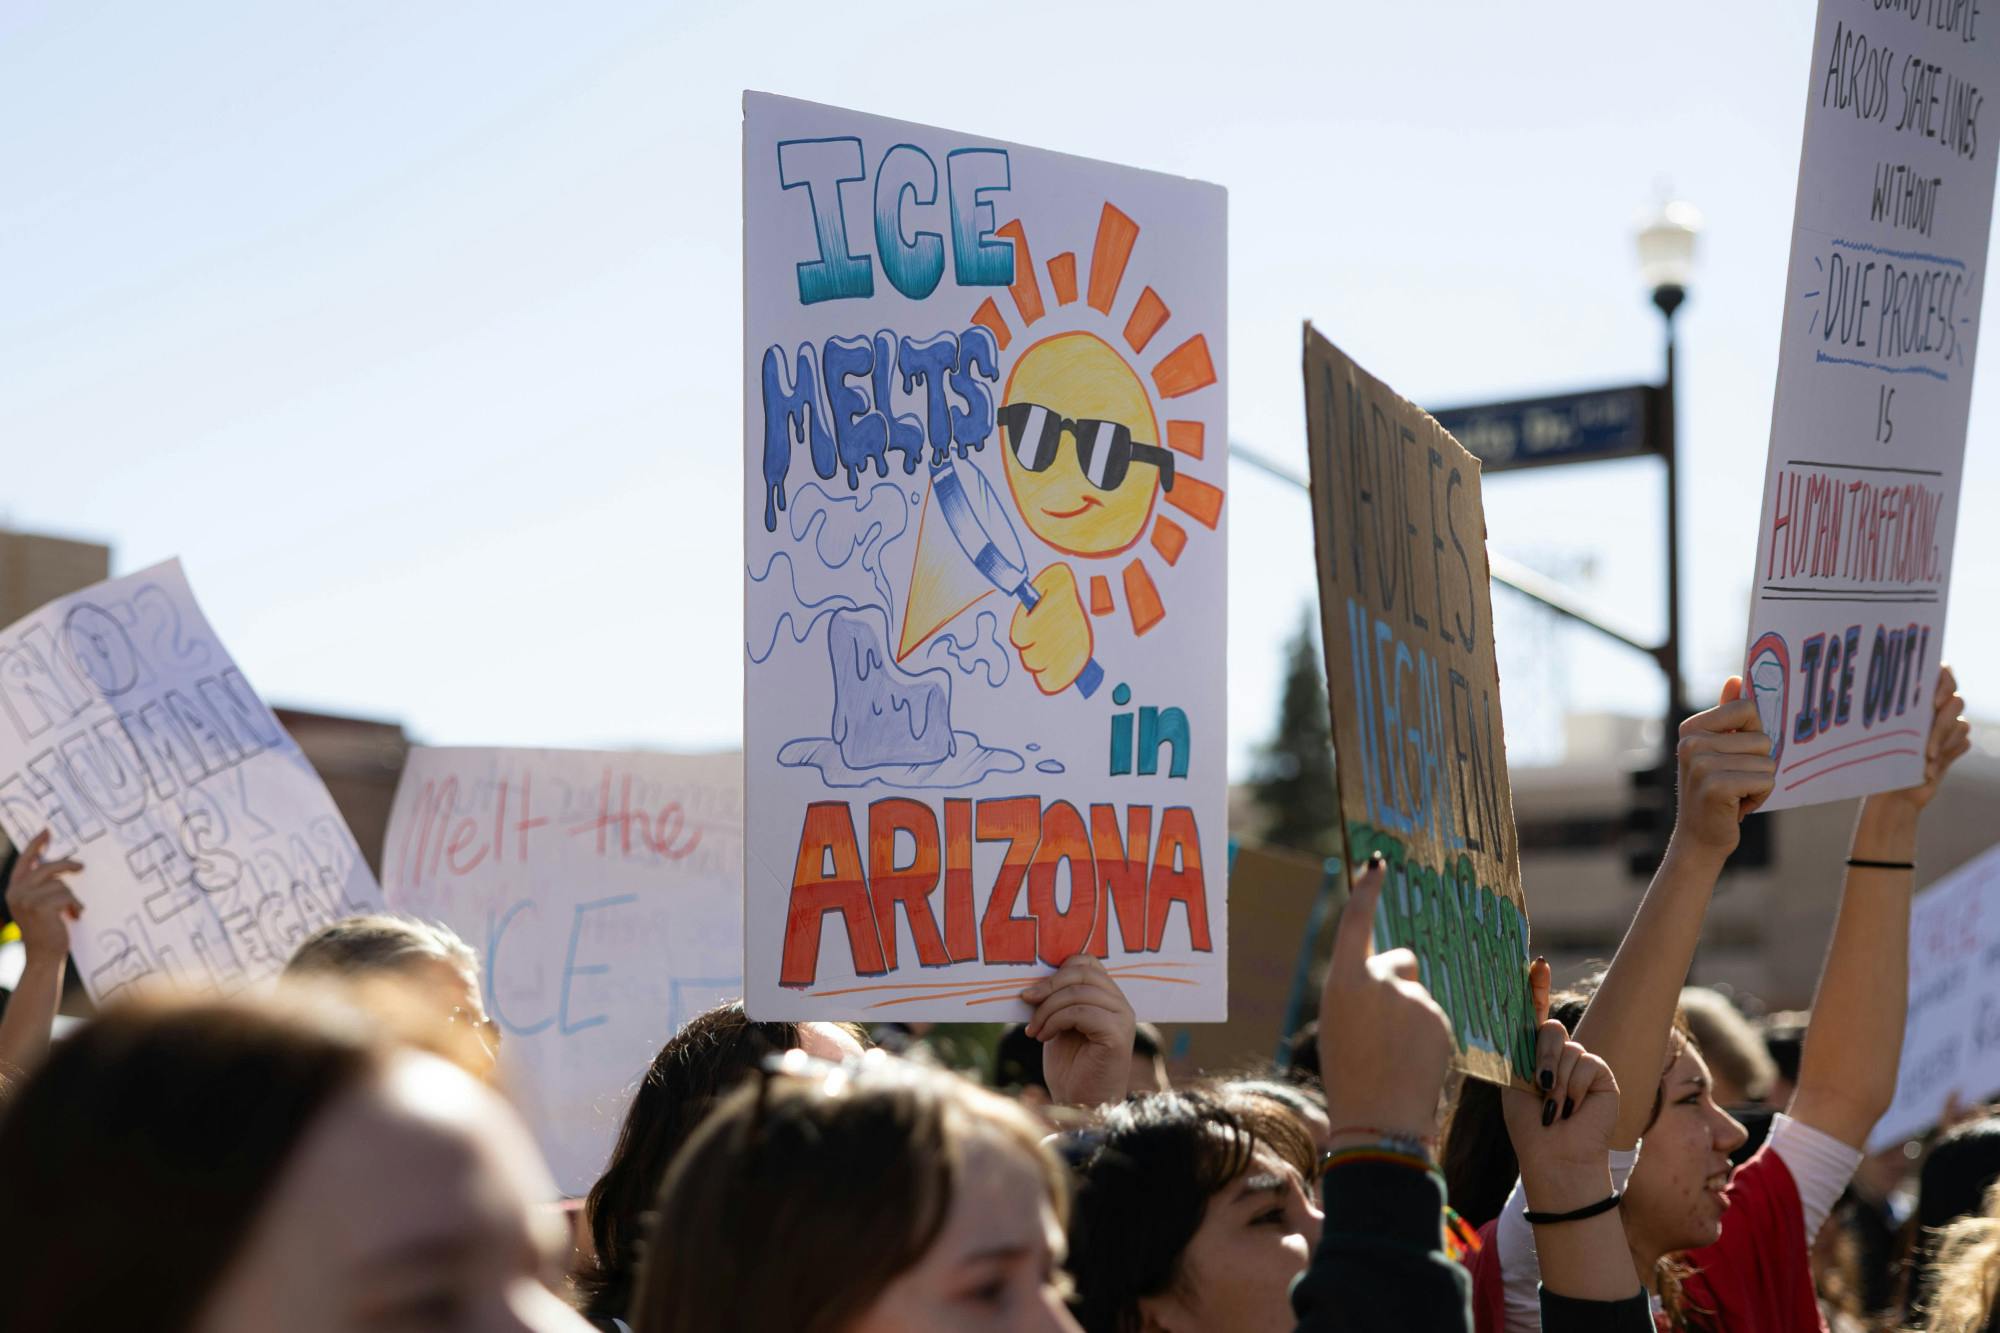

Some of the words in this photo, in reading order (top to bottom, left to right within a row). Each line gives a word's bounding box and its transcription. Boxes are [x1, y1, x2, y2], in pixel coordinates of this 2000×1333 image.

[1823, 20, 1894, 123] ACROSS
[1895, 54, 1943, 138] STATE
[1940, 73, 1983, 160] LINES
[777, 136, 1016, 306] ICE
[1870, 162, 1943, 238] WITHOUT
[1824, 252, 1876, 348] DUE
[1877, 262, 1964, 361] PROCESS
[762, 326, 1000, 533] MELTS
[1875, 384, 1896, 444] IS
[1324, 361, 1428, 631] NADIE
[1428, 447, 1476, 654] ES
[1767, 471, 1845, 582] HUMAN
[0, 602, 139, 745] NO
[1109, 682, 1191, 780] in
[1347, 596, 1466, 849] ILEGAL
[1449, 668, 1504, 864] EN
[1792, 623, 1862, 745] ICE
[1861, 622, 1931, 731] OUT!
[0, 665, 282, 863] HUMAN
[567, 768, 703, 861] the
[126, 808, 245, 923] IS
[778, 794, 1214, 990] ARIZONA
[485, 893, 640, 1036] ICE
